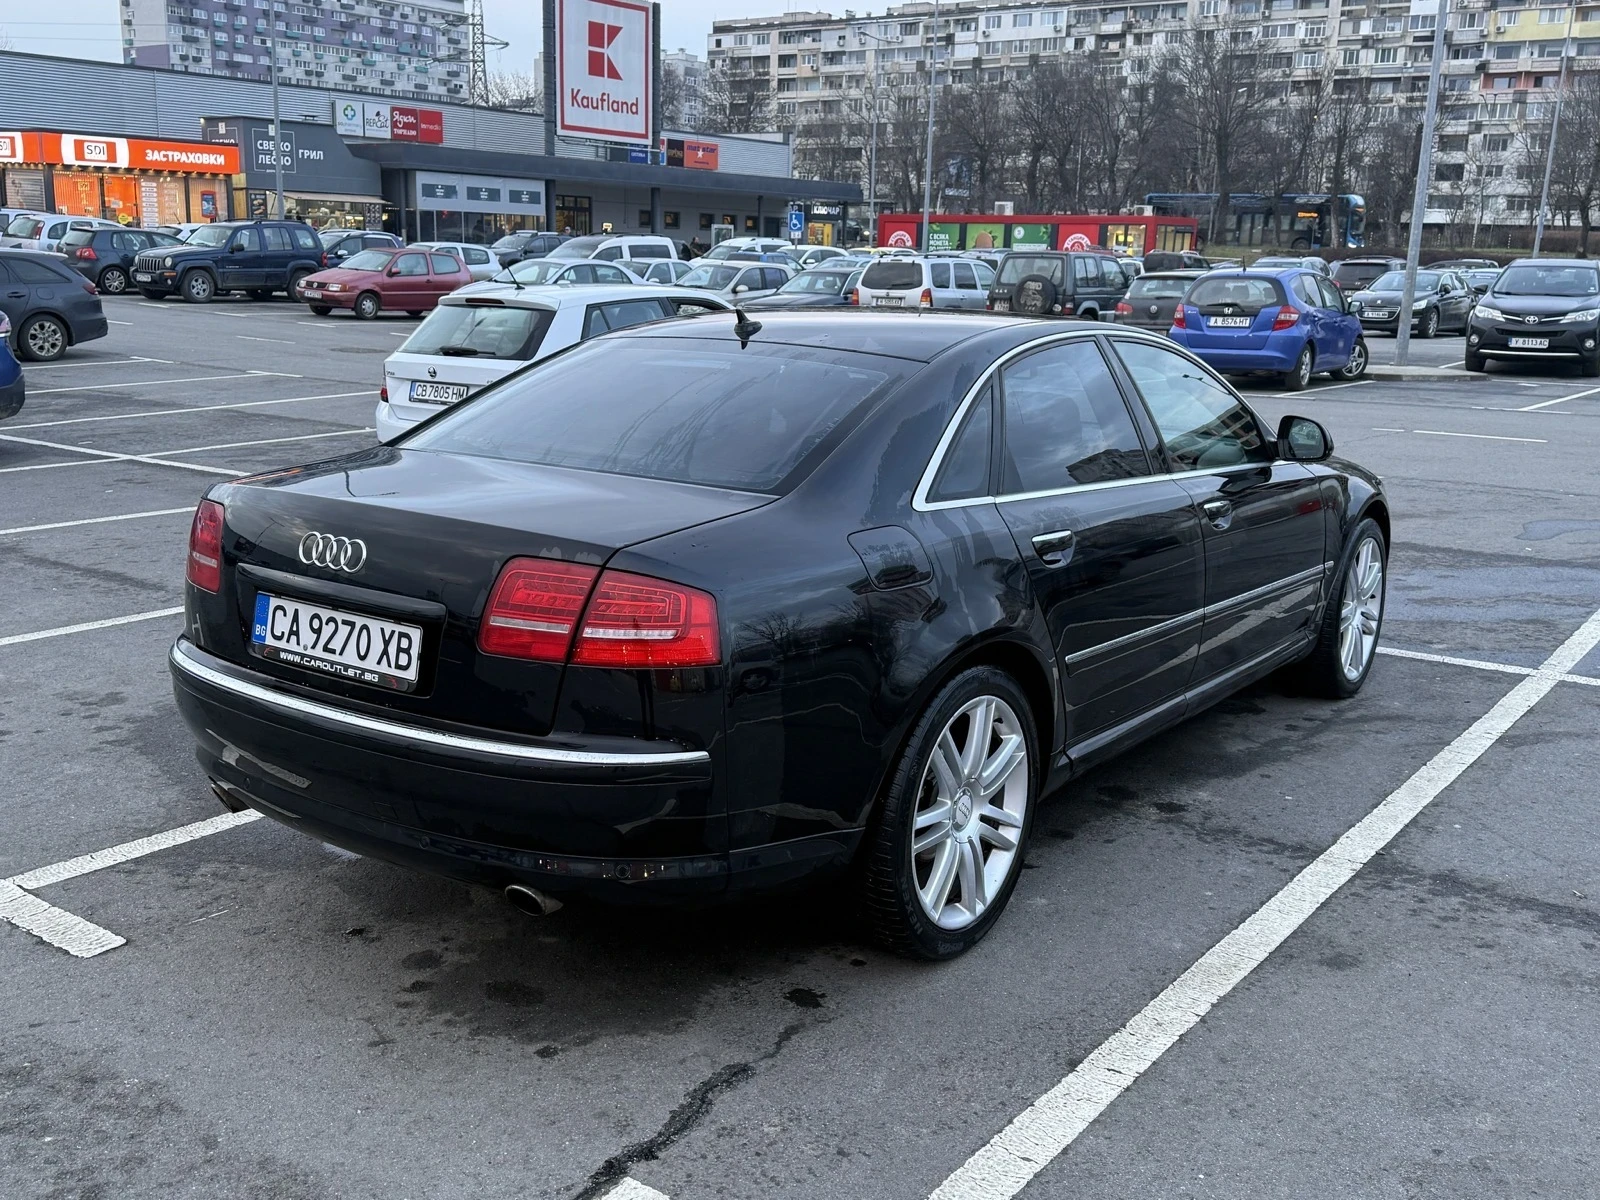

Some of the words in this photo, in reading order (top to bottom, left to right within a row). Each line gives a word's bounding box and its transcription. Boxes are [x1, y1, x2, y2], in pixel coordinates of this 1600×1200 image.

[570, 87, 639, 115] Kaufland
[86, 144, 106, 156] SDI
[298, 149, 324, 160] ГРИЛ
[145, 149, 225, 166] ЗАСТРАХОВКИ
[813, 205, 840, 215] КЛЮЧАР
[1221, 317, 1238, 325] 8576
[1239, 318, 1249, 326] HT
[1521, 338, 1537, 346] 8113
[415, 384, 427, 397] CB
[427, 385, 450, 399] 7805
[255, 624, 266, 636] BG
[270, 604, 301, 646] CA
[308, 612, 372, 661] 9270
[376, 627, 413, 671] XB
[280, 651, 379, 682] WWW.CAROUTLET.BG
